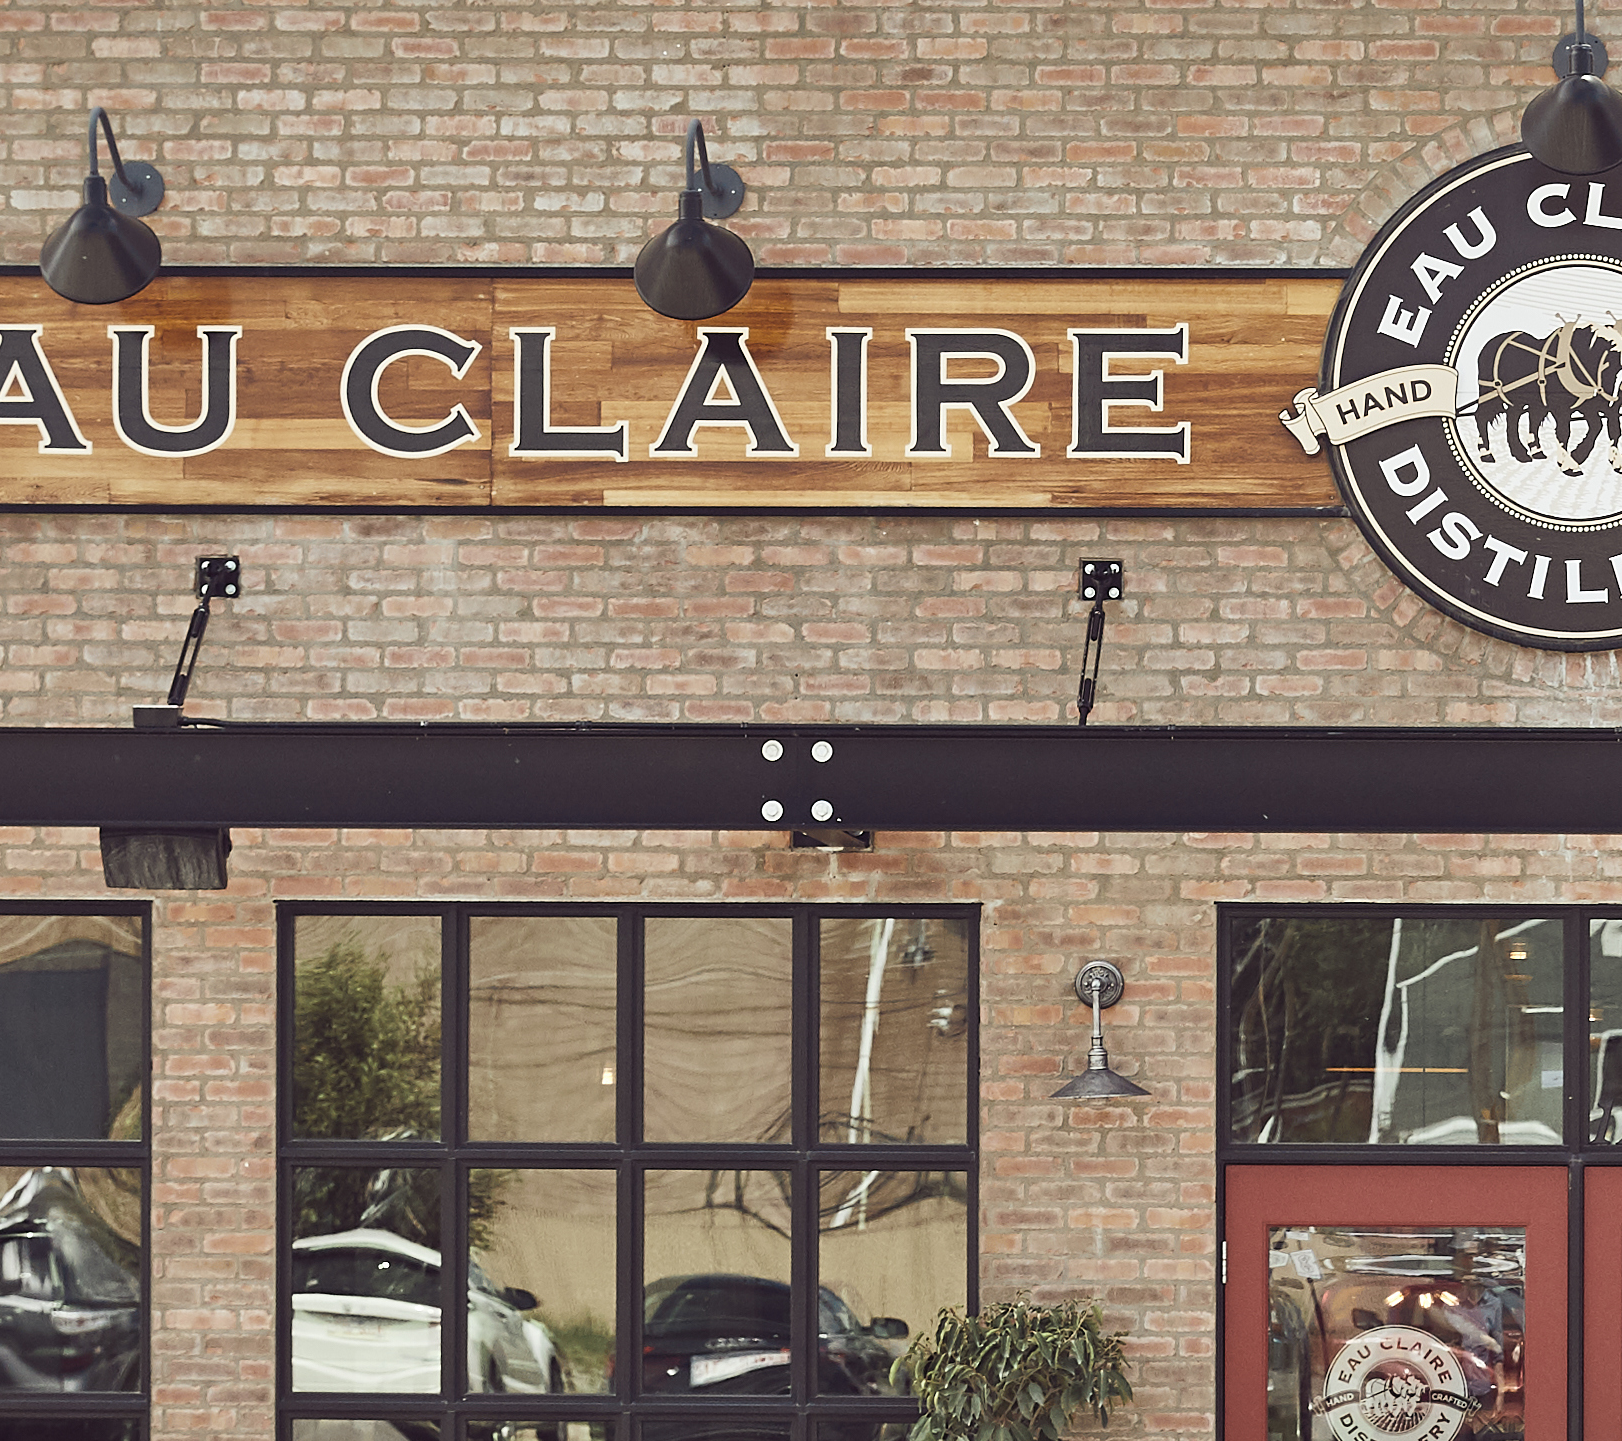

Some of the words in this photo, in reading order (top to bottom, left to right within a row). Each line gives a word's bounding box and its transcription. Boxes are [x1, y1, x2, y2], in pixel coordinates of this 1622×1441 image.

[1378, 206, 1497, 348] EAU
[341, 321, 1192, 464] CLAIRE
[1336, 380, 1432, 425] HAND
[1338, 1345, 1371, 1384] EAU
[1380, 1338, 1452, 1384] CLAIRE
[1327, 1393, 1354, 1407] HAND
[1431, 1392, 1467, 1409] CRAFTED
